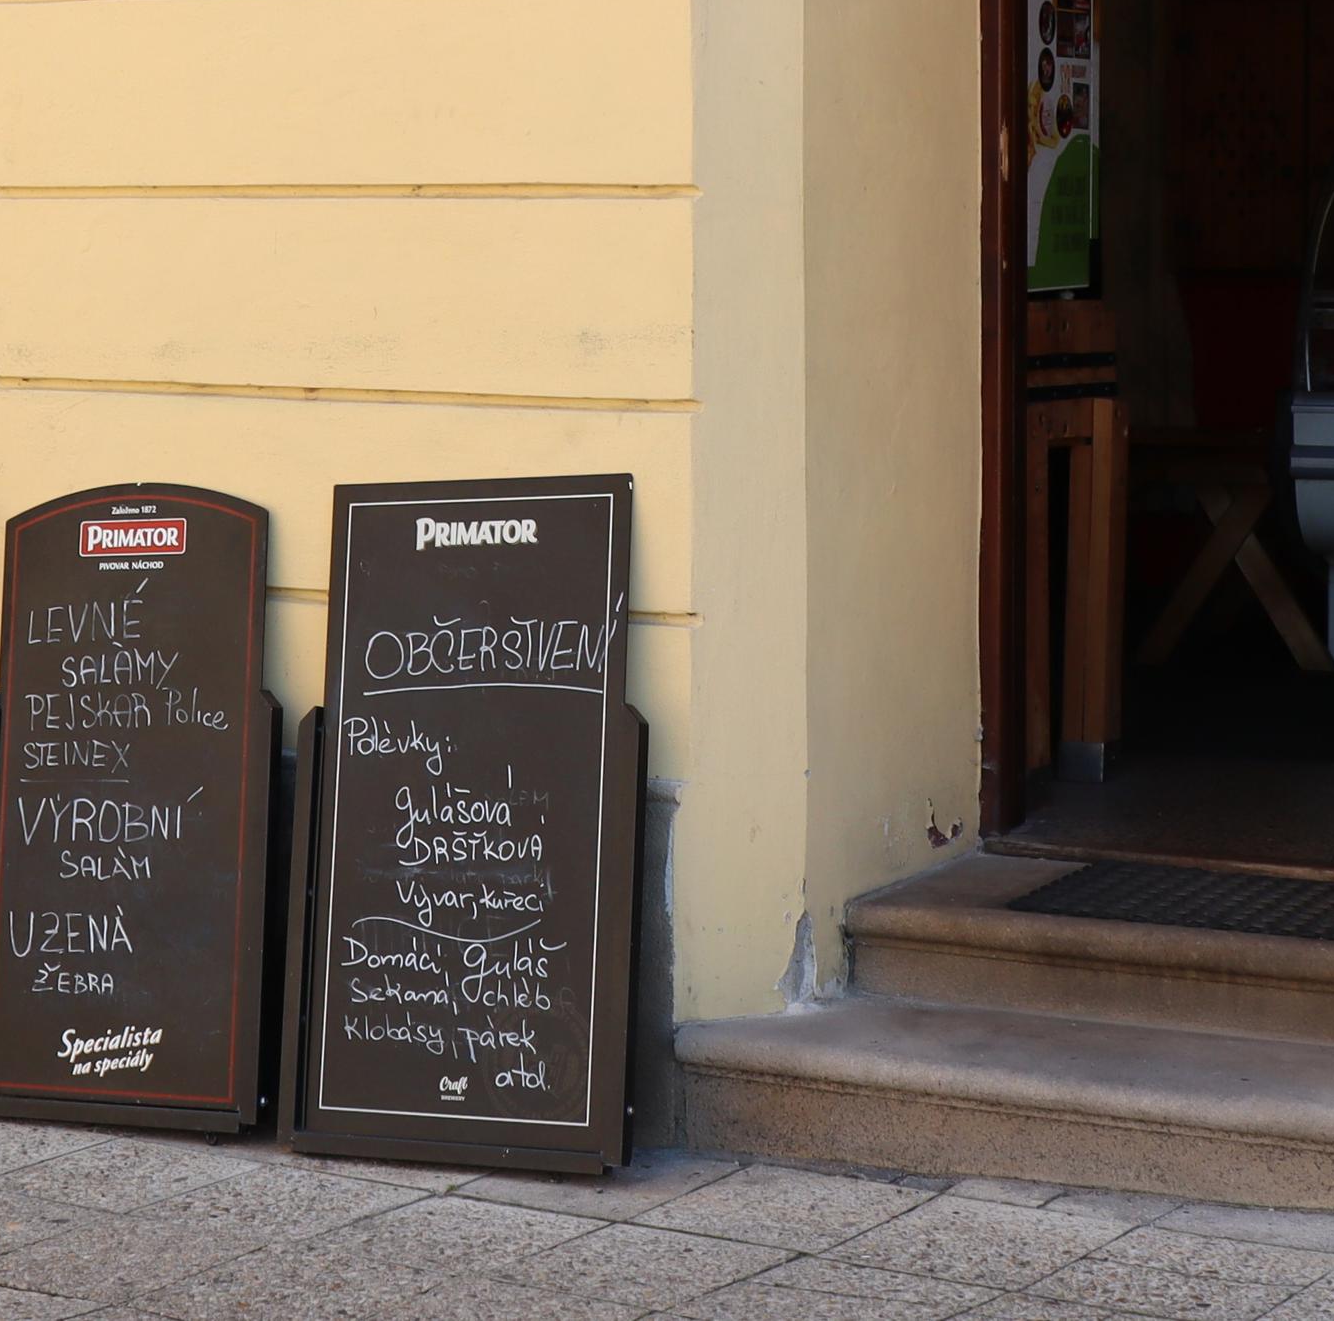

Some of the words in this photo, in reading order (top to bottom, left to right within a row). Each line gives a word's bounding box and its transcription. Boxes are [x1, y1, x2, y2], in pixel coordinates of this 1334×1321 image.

[141, 505, 157, 514] 1872
[99, 561, 130, 571] PIVOVAR
[131, 559, 164, 570] NÁCHOD
[27, 577, 149, 646] LEVNÉ
[23, 740, 130, 774] STEINEX
[57, 1026, 163, 1063] Specialista
[72, 1061, 92, 1075] na
[93, 1048, 154, 1077] speciály
[495, 1052, 551, 1091] atd.
[439, 1076, 468, 1095] Craft
